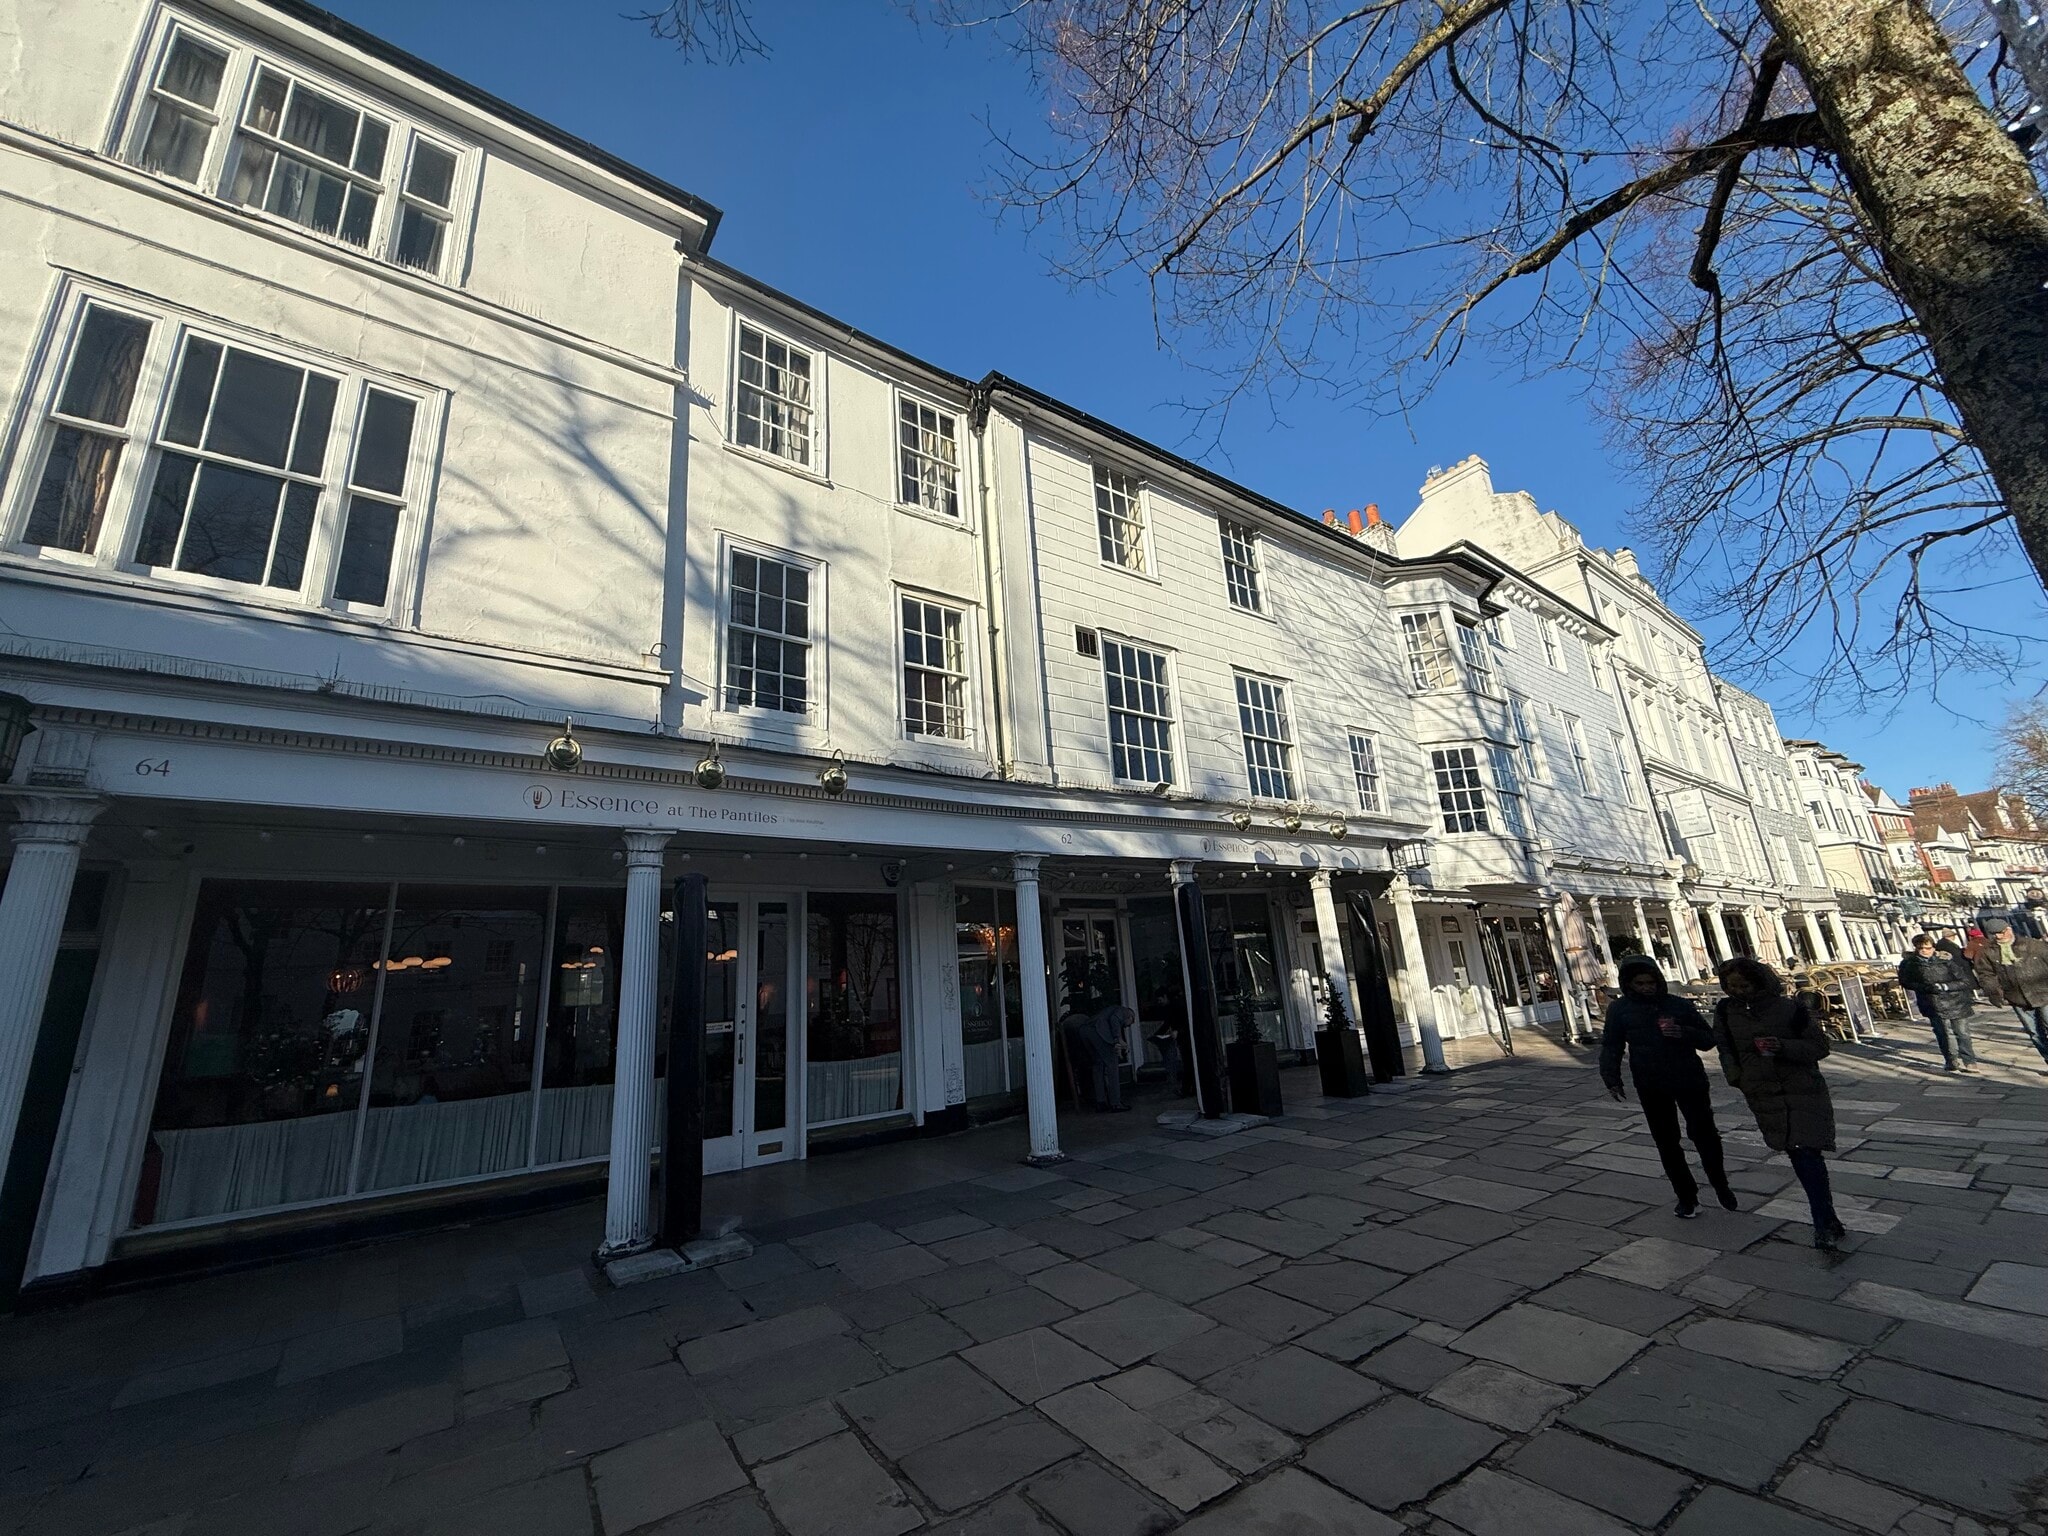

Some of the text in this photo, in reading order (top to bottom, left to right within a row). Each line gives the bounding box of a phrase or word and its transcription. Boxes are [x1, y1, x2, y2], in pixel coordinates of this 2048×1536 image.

[135, 758, 170, 777] 64
[561, 789, 659, 815] Essence
[667, 806, 683, 817] at
[688, 805, 717, 819] The
[721, 808, 778, 824] Pantiles
[1061, 833, 1072, 845] 62
[1213, 840, 1249, 854] Essence
